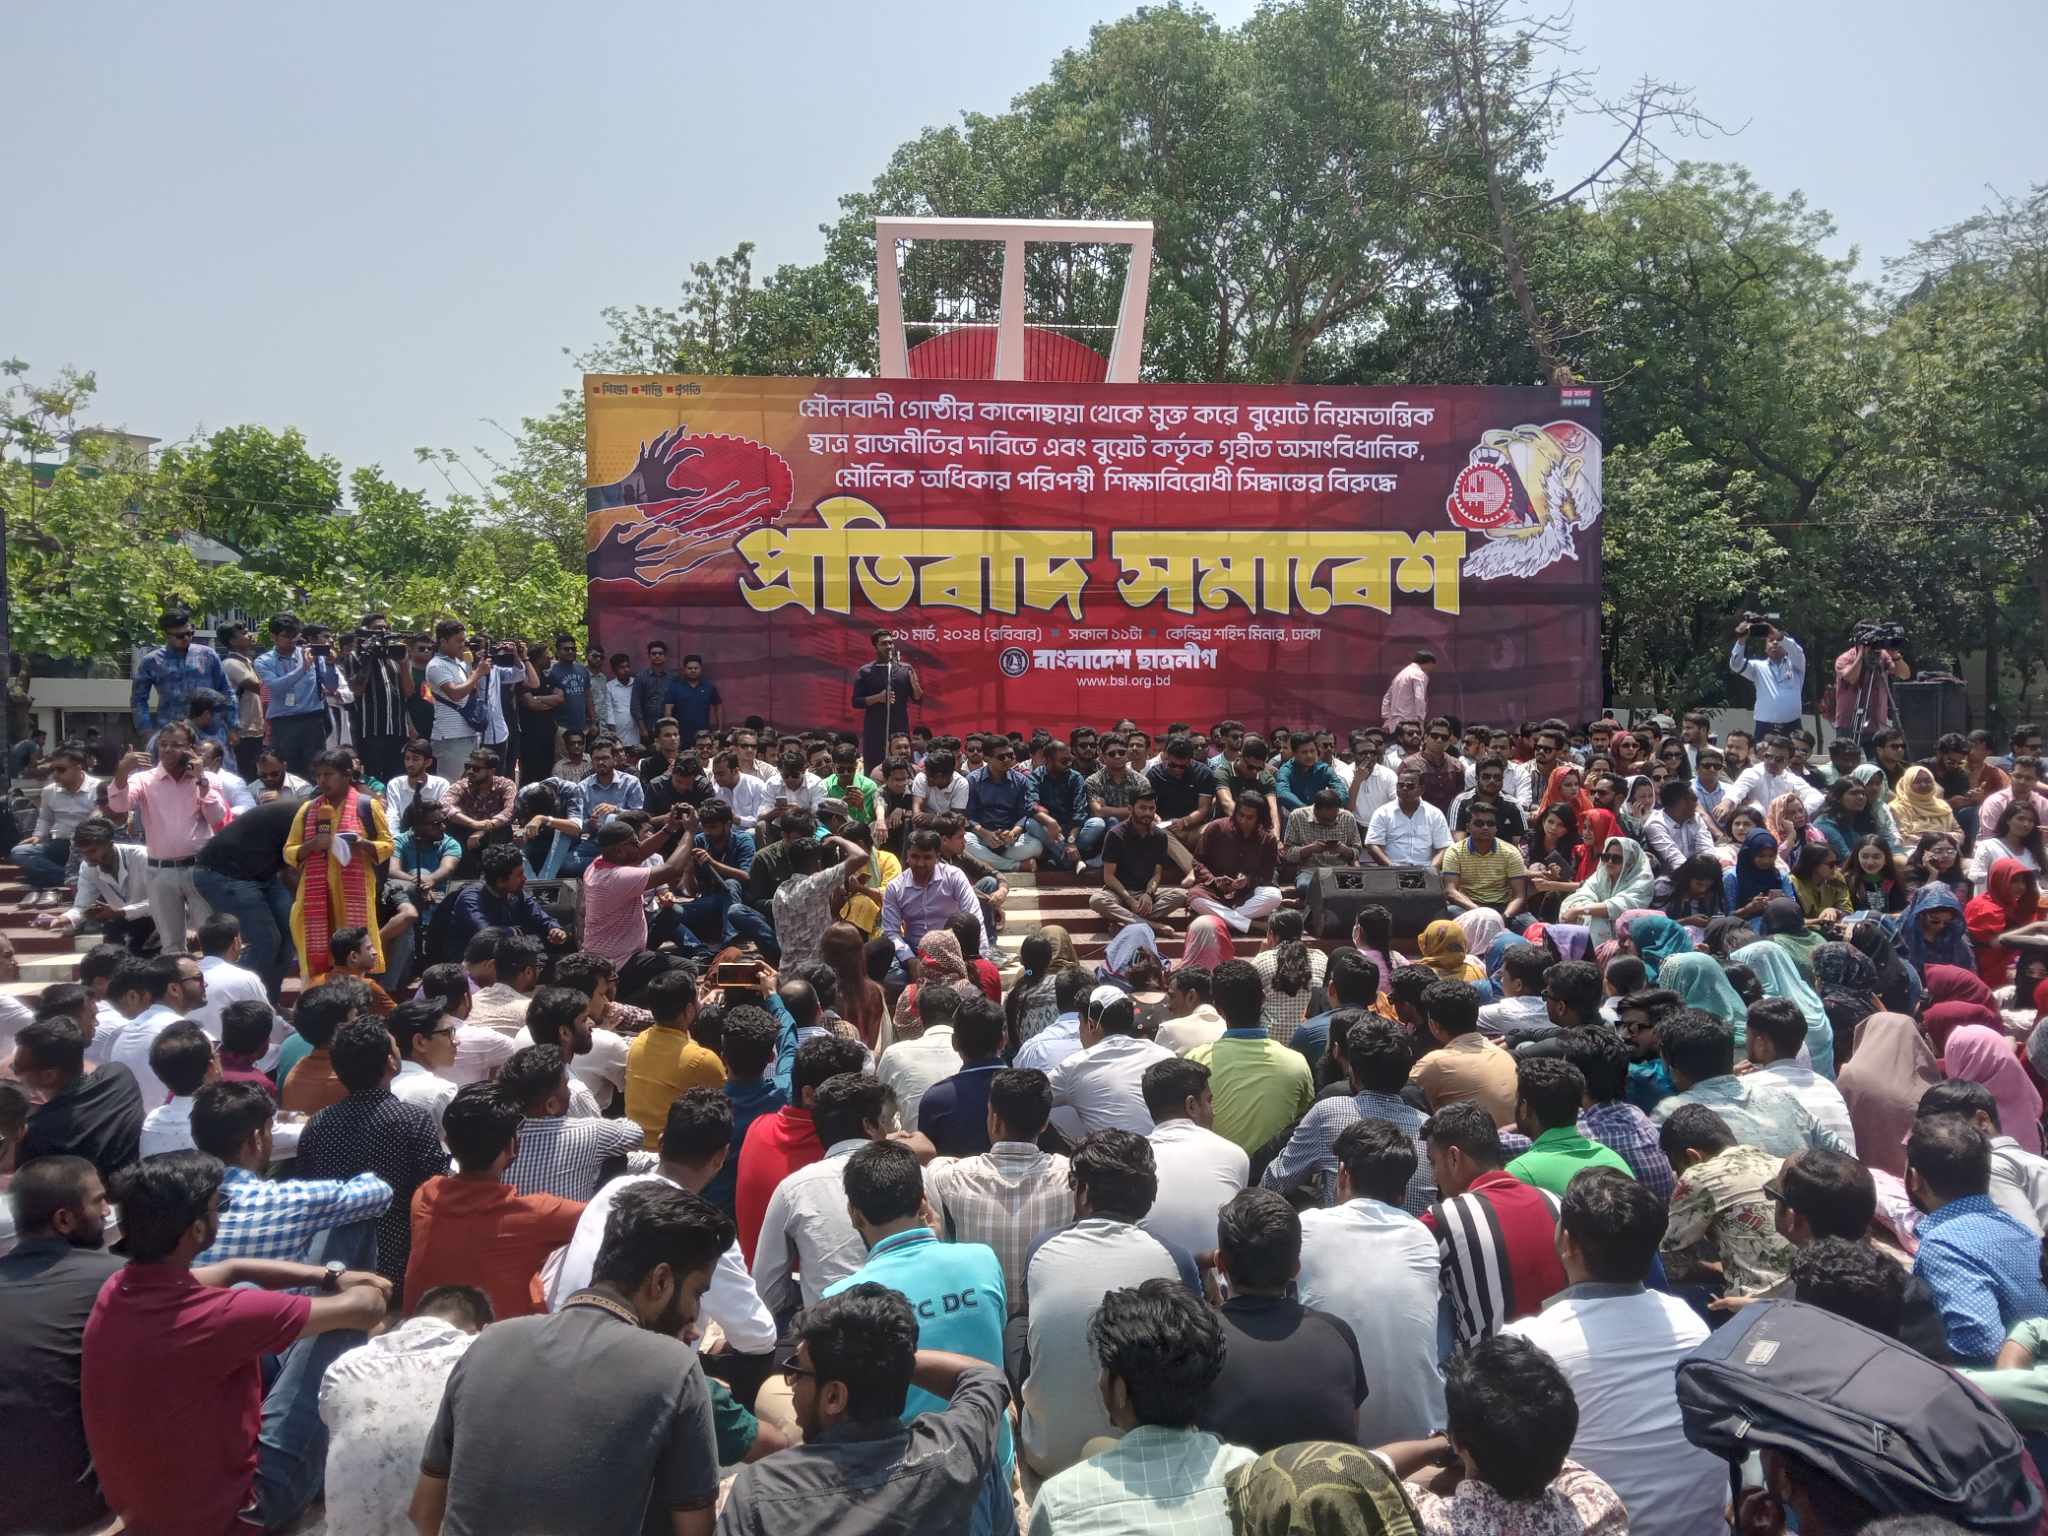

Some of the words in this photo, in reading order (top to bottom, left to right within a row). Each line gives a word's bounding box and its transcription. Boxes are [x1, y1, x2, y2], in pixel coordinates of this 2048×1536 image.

[799, 393, 894, 418] মৌলবাদী
[900, 394, 973, 422] গোষ্ঠীর
[980, 403, 1084, 425] কালোছায়া
[1090, 405, 1144, 424] থেকে
[1149, 405, 1188, 431] মুক্ত
[1193, 405, 1238, 424] করে
[1248, 402, 1308, 431] বুয়েটে
[1314, 401, 1434, 427] নিয়মতান্ত্রিক
[808, 433, 849, 455] ছাত্র
[854, 428, 964, 456] রাজনীতির
[968, 431, 1037, 456] দাবিতে
[1043, 438, 1085, 457] এবং
[1092, 439, 1147, 465] বুয়েট
[1151, 432, 1214, 465] কর্তৃক
[1219, 432, 1273, 465] গৃহীত
[1277, 434, 1425, 461] অসাংবিধানিক,
[835, 463, 914, 488] মৌলিক
[920, 464, 1011, 489] অধিকার
[1017, 465, 1095, 493] পরিপন্থী
[1104, 467, 1232, 493] শিক্ষাবিরোধী
[1237, 468, 1323, 493] সিদ্ধান্তের
[1329, 468, 1397, 493] বিরুদ্ধে
[734, 496, 1094, 621] প্রতিবাদ
[1111, 529, 1466, 616] সমাবেশ
[911, 624, 939, 642] মার্চ,
[944, 628, 980, 641] ২০২৪
[984, 625, 1042, 642] (রবিবার)
[1068, 628, 1108, 641] সকাল
[1111, 626, 1142, 640] ১১টা
[1214, 625, 1246, 641] শহিদ
[1248, 625, 1289, 642] মিনার,
[1291, 628, 1321, 641] ঢাকা
[1032, 649, 1131, 670] বাংলাদেশ
[1135, 642, 1218, 670] ছাত্রলীগ
[1076, 674, 1171, 688] www.bsl.org.bd
[909, 1298, 936, 1317] C
[942, 1288, 977, 1314] DC
